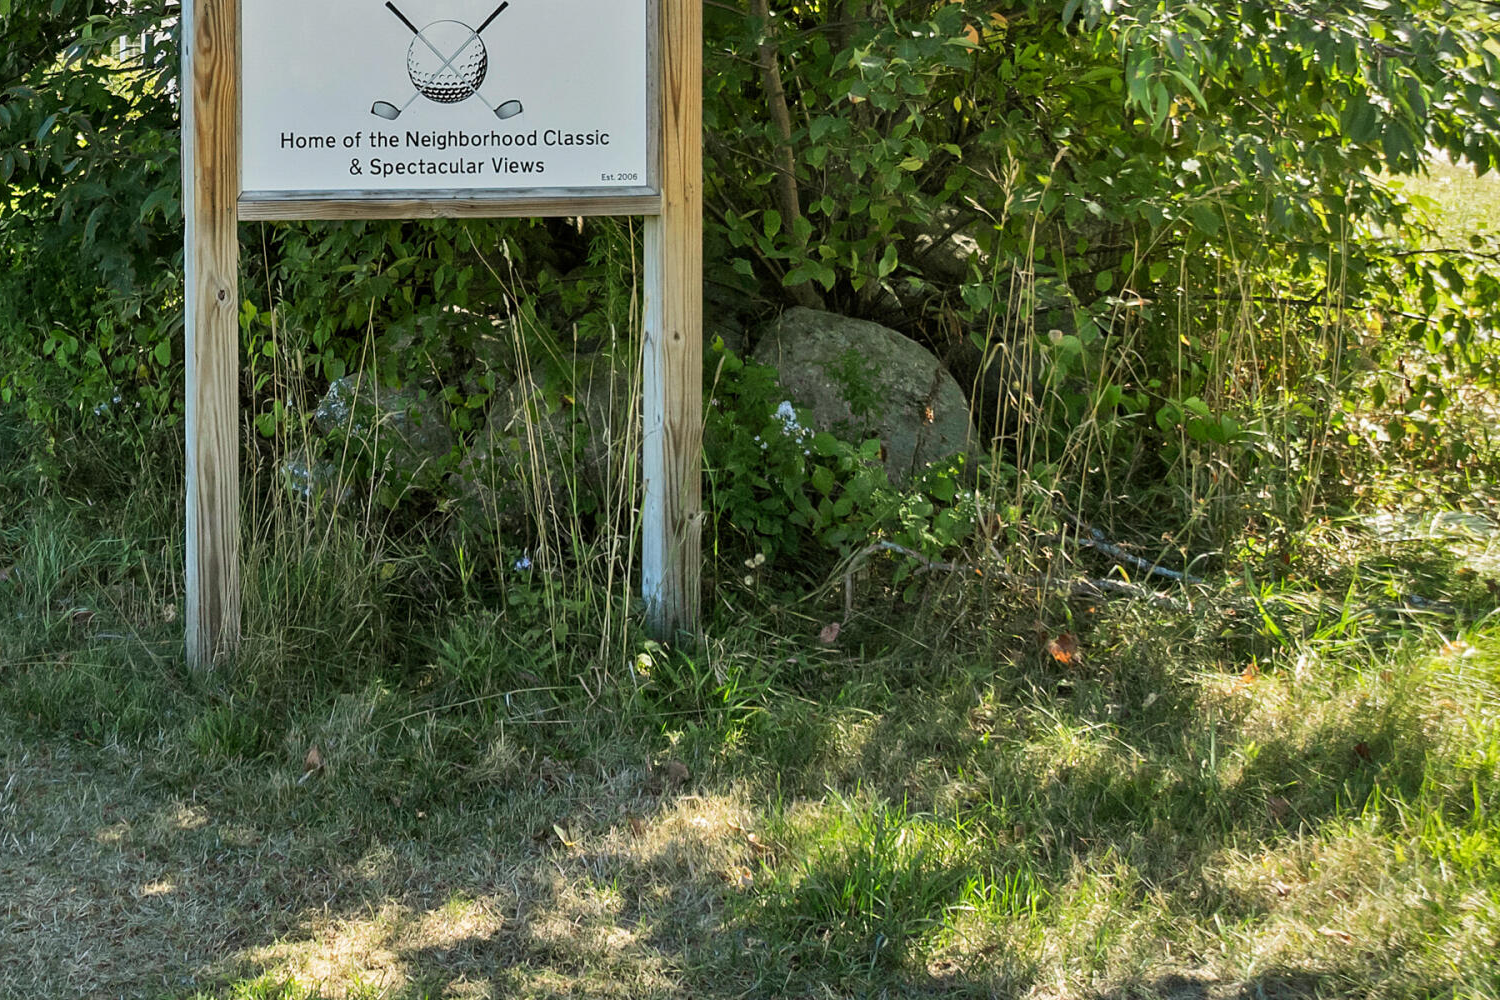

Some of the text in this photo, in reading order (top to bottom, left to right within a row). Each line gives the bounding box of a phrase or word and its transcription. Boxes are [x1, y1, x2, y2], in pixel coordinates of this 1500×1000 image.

[280, 129, 610, 151] Home of the Neighborhood Classic
[349, 157, 545, 178] & Spectacular Views
[601, 172, 638, 181] Est. 2006
